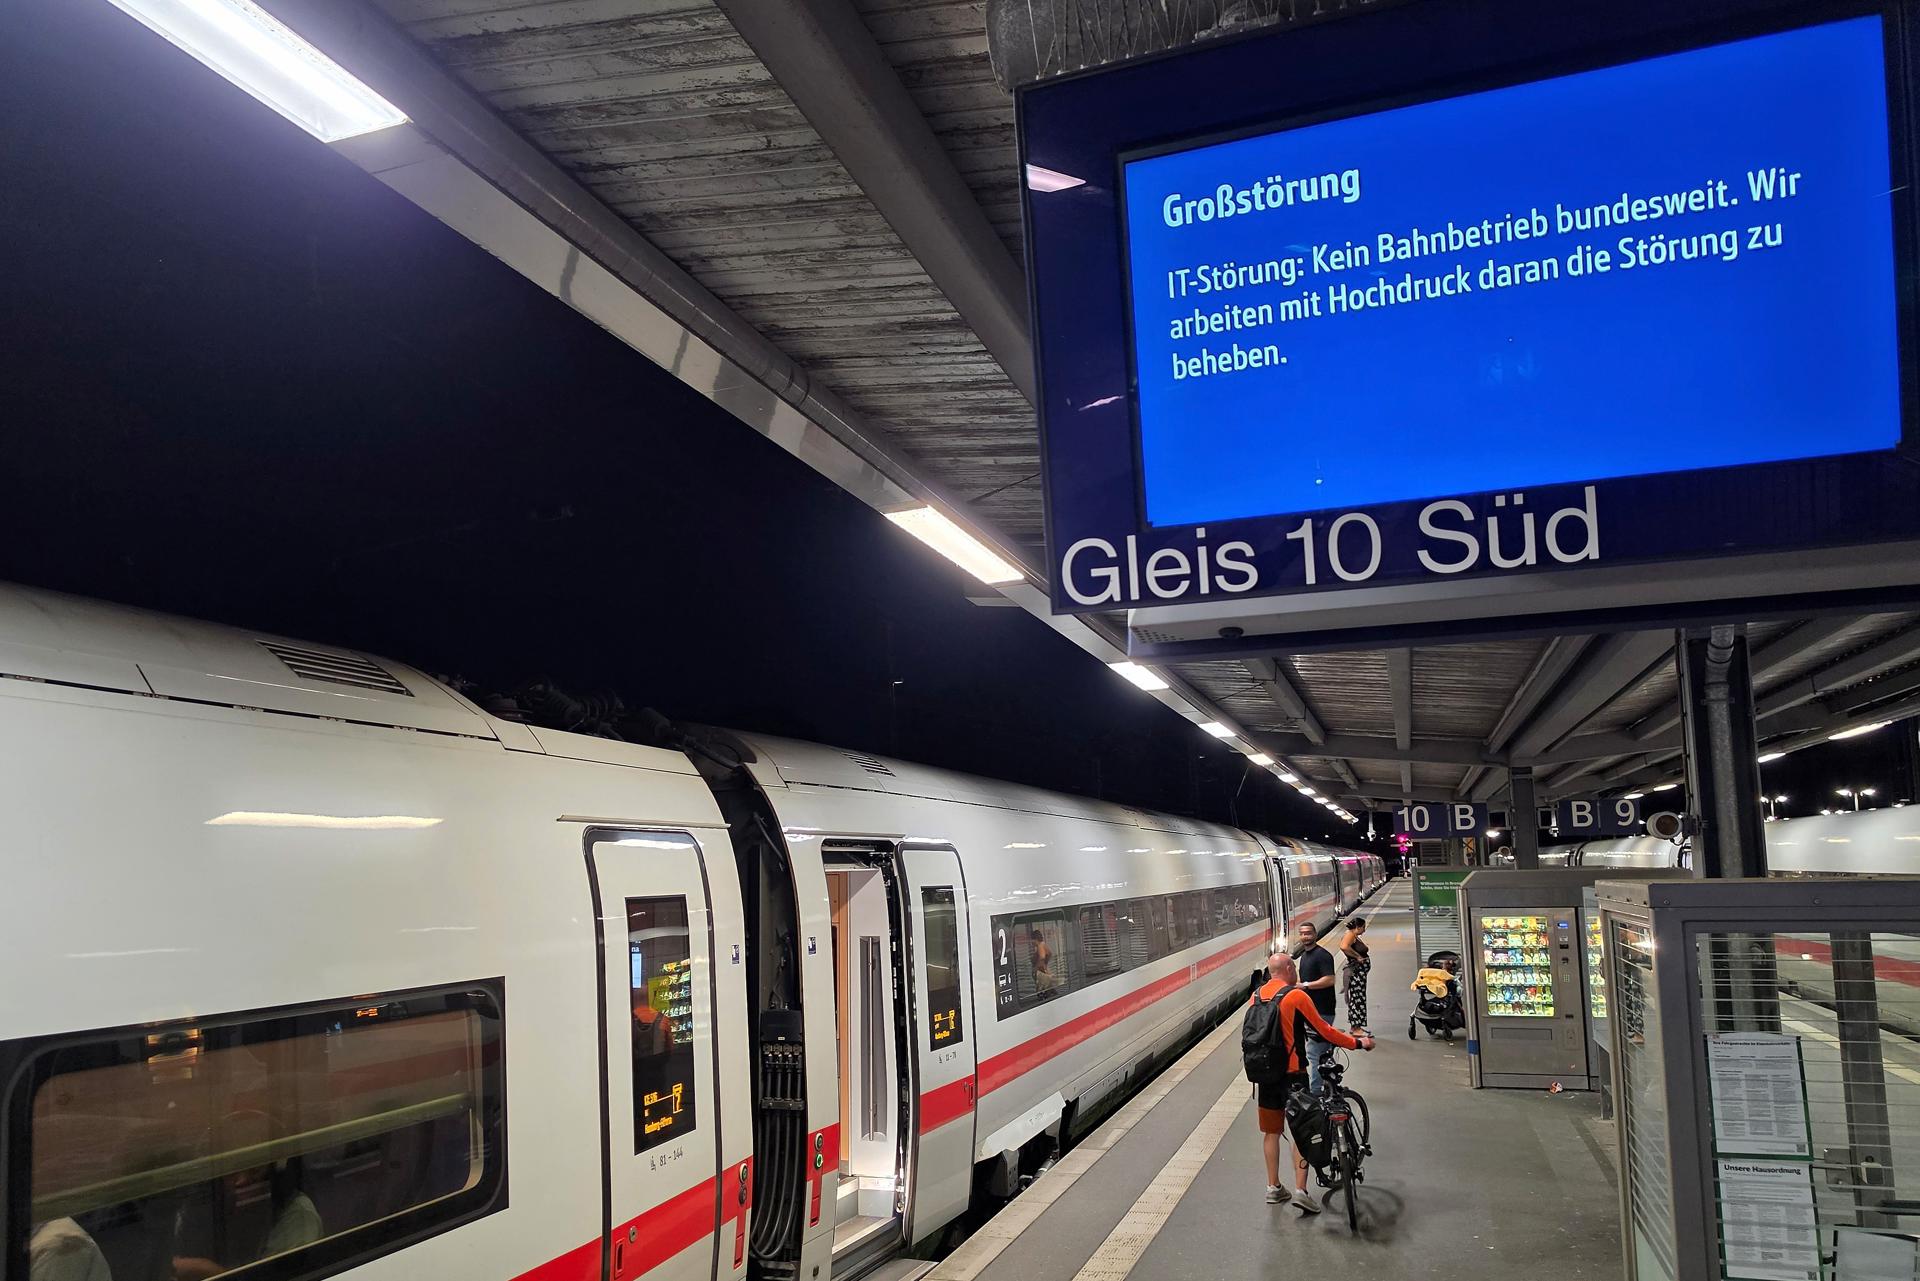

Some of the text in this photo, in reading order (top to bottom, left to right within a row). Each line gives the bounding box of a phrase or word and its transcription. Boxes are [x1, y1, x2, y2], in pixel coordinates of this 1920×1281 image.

[1163, 169, 1360, 228] Großstörung
[1168, 167, 1801, 299] IT-Störung: Kein Bahnbetrieb bundesweit. Wir
[1170, 223, 1783, 339] arbeiten mit Hochdruck daran die Störung zu
[1173, 343, 1287, 380] beheben.
[1061, 486, 1600, 606] Gleis 10 Süd
[1397, 804, 1476, 832] 10 B
[1571, 800, 1635, 828] B 9
[998, 928, 1008, 966] 2
[1724, 1164, 1750, 1173] Unsere
[1752, 1165, 1801, 1175] Hausordnung
